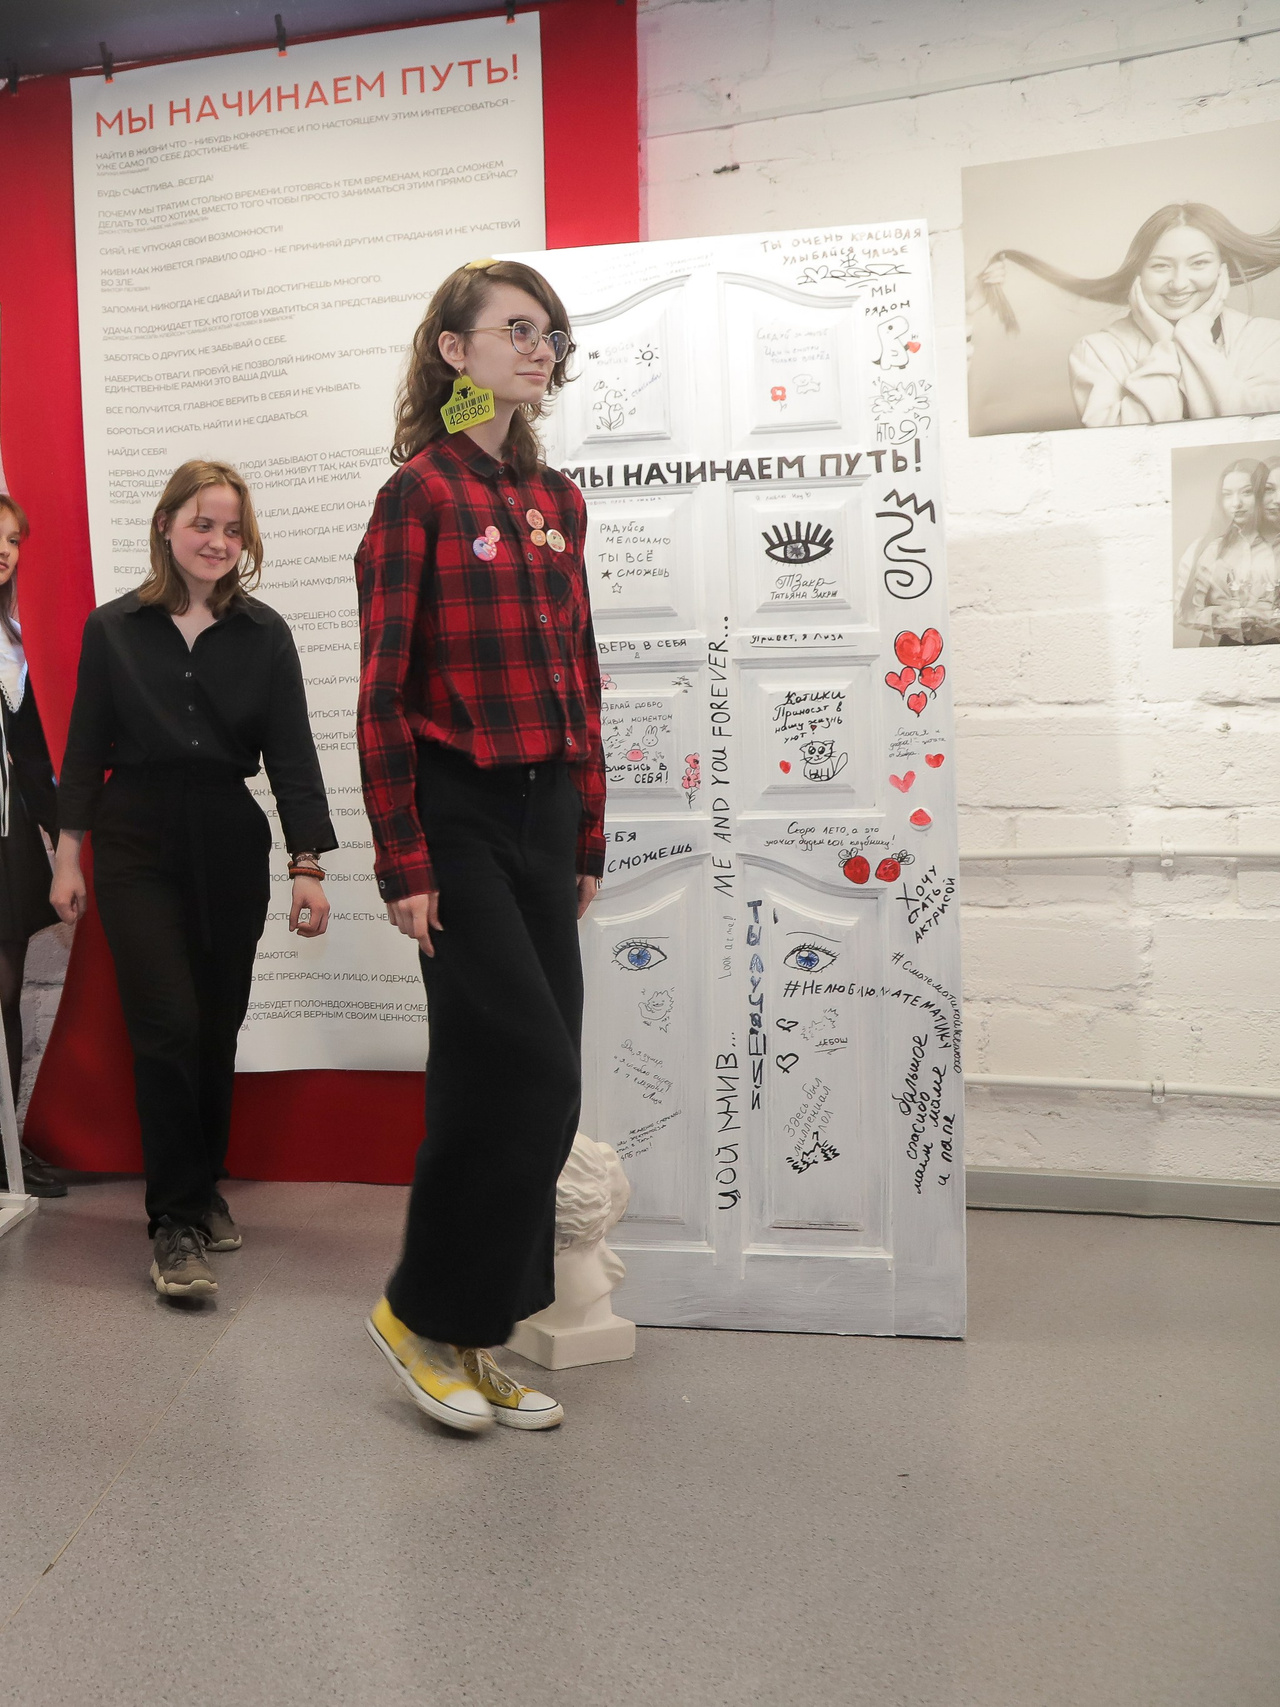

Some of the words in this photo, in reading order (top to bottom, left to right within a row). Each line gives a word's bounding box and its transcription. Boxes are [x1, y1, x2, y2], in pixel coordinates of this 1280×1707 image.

[95, 104, 154, 137] МЫ
[168, 71, 385, 127] НАЧИНАЕМ
[401, 53, 519, 95] ПУТЬ!
[233, 125, 295, 140] КОНКРЕТНОЕ
[322, 113, 390, 130] НАСТОЯЩЕМУ
[119, 157, 145, 168] САМО
[160, 151, 182, 162] СЕБЕ
[341, 183, 405, 198] ЗАНИМАТЬСЯ
[474, 168, 518, 182] СЕЙЧАС?
[97, 187, 121, 198] БУДЬ
[191, 193, 233, 206] СТОЛЬКО
[283, 181, 333, 194] ГОТОВЯСЬ
[141, 239, 182, 253] УПУСКАЯ
[208, 225, 284, 243] ВОЗМОЖНОСТИ!
[289, 238, 342, 253] ПРИЧИНЯЙ
[385, 228, 444, 244] СТРАДАНИЯ
[760, 240, 782, 253] ТЫ
[792, 233, 843, 247] ОЧЕНЬ
[851, 228, 922, 242] КРАСИВАЯ
[782, 246, 854, 266] УЛЫБАЙСЯ
[862, 245, 909, 259] ЧАЩЕ
[150, 298, 193, 312] НИКОГДА
[266, 278, 332, 296] ДОСТИГНЕШЬ
[871, 282, 897, 297] МЫ
[865, 300, 911, 317] РЯДОМ
[134, 320, 192, 335] ПОДЖИДАЕТ
[260, 303, 319, 317] УХВАТИТЬСЯ
[103, 353, 151, 361] ЗАБОТЯСЬ
[211, 338, 253, 352] ЗАБЫВАЙ
[588, 350, 601, 360] НЕ
[104, 374, 153, 383] НАБЕРИСЬ
[244, 354, 294, 370] ПОЗВОЛЯЙ
[104, 383, 179, 394] ЕДИНСТВЕННЫЕ
[181, 378, 213, 390] РАМКИ
[183, 398, 224, 411] ГЛАВНОЕ
[226, 394, 260, 405] ВЕРИТЬ
[107, 426, 155, 435] БОРОТЬСЯ
[203, 417, 234, 430] НАЙТИ
[107, 446, 140, 457] НАЙДИ
[141, 448, 168, 456] СЕБЯ!
[239, 459, 267, 471] ЛЮДИ
[269, 453, 319, 467] ЗАБЫВАЮТ
[285, 464, 318, 476] ЖИВУТ
[360, 459, 390, 468] БУДТО
[561, 465, 613, 488] МЫ
[623, 455, 806, 486] НАЧИНАЕМ
[820, 438, 921, 476] ПУТЬ!
[109, 469, 146, 477] НЕРВНО
[265, 477, 307, 489] НИКОГДА
[109, 490, 139, 499] КОГДА
[292, 504, 319, 515] ДАЖЕ
[321, 502, 345, 511] ЕСЛИ
[288, 525, 331, 538] НИКОГДА
[599, 521, 645, 534] РАДУЙСЯ
[112, 539, 135, 548] БУДЬ
[303, 555, 337, 565] САМЫЕ
[598, 553, 619, 563] ТЫ
[625, 549, 653, 563] ВСЁ
[113, 566, 147, 574] ВСЕГДА
[616, 568, 670, 578] СМОЖЕШЬ
[317, 620, 339, 631] ЕСТЬ
[643, 640, 652, 651] В
[657, 638, 687, 648] СЕБЯ
[635, 701, 664, 709] ДОБРО
[711, 746, 730, 786] YOU
[634, 770, 669, 784] СЕБЯ!
[336, 808, 361, 817] ТВОИ
[712, 797, 731, 844] AND
[607, 842, 693, 874] СМОЖЕШЬ
[712, 855, 736, 898] ME
[908, 889, 941, 925] СТАТЬ
[914, 877, 956, 944] АКТРИСОЙ
[353, 912, 375, 921] ЕСТЬ
[304, 1010, 344, 1019] ВЕРНЫМ
[929, 1064, 947, 1128] маме
[783, 1101, 810, 1139] Здесь
[801, 1075, 823, 1101] был
[794, 1085, 832, 1158] миллениал
[906, 1091, 931, 1160] спасибо
[941, 1113, 956, 1163] папе
[937, 1173, 950, 1186] и
